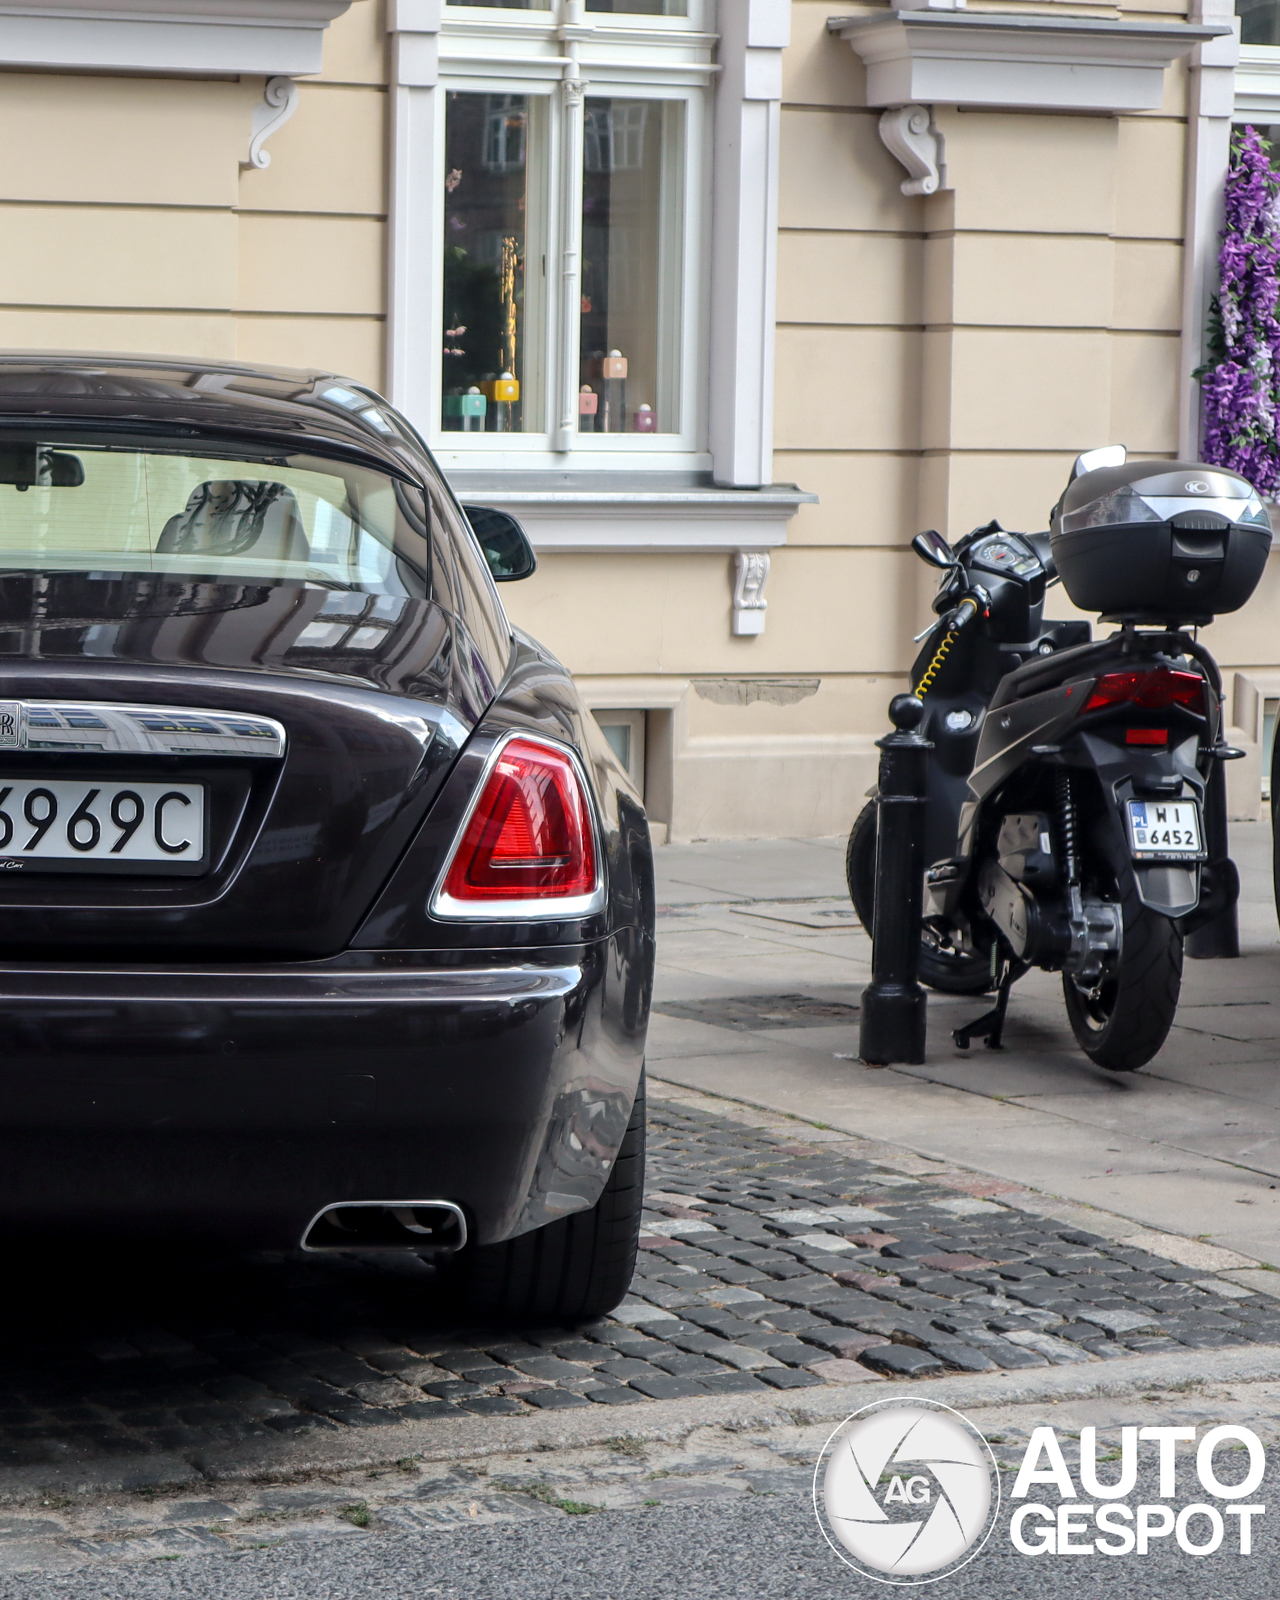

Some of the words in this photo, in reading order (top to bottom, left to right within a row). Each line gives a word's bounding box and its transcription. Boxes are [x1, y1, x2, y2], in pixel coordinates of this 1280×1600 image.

[1132, 816, 1148, 827] PL
[1150, 830, 1194, 845] 6452
[6, 861, 24, 869] Cars
